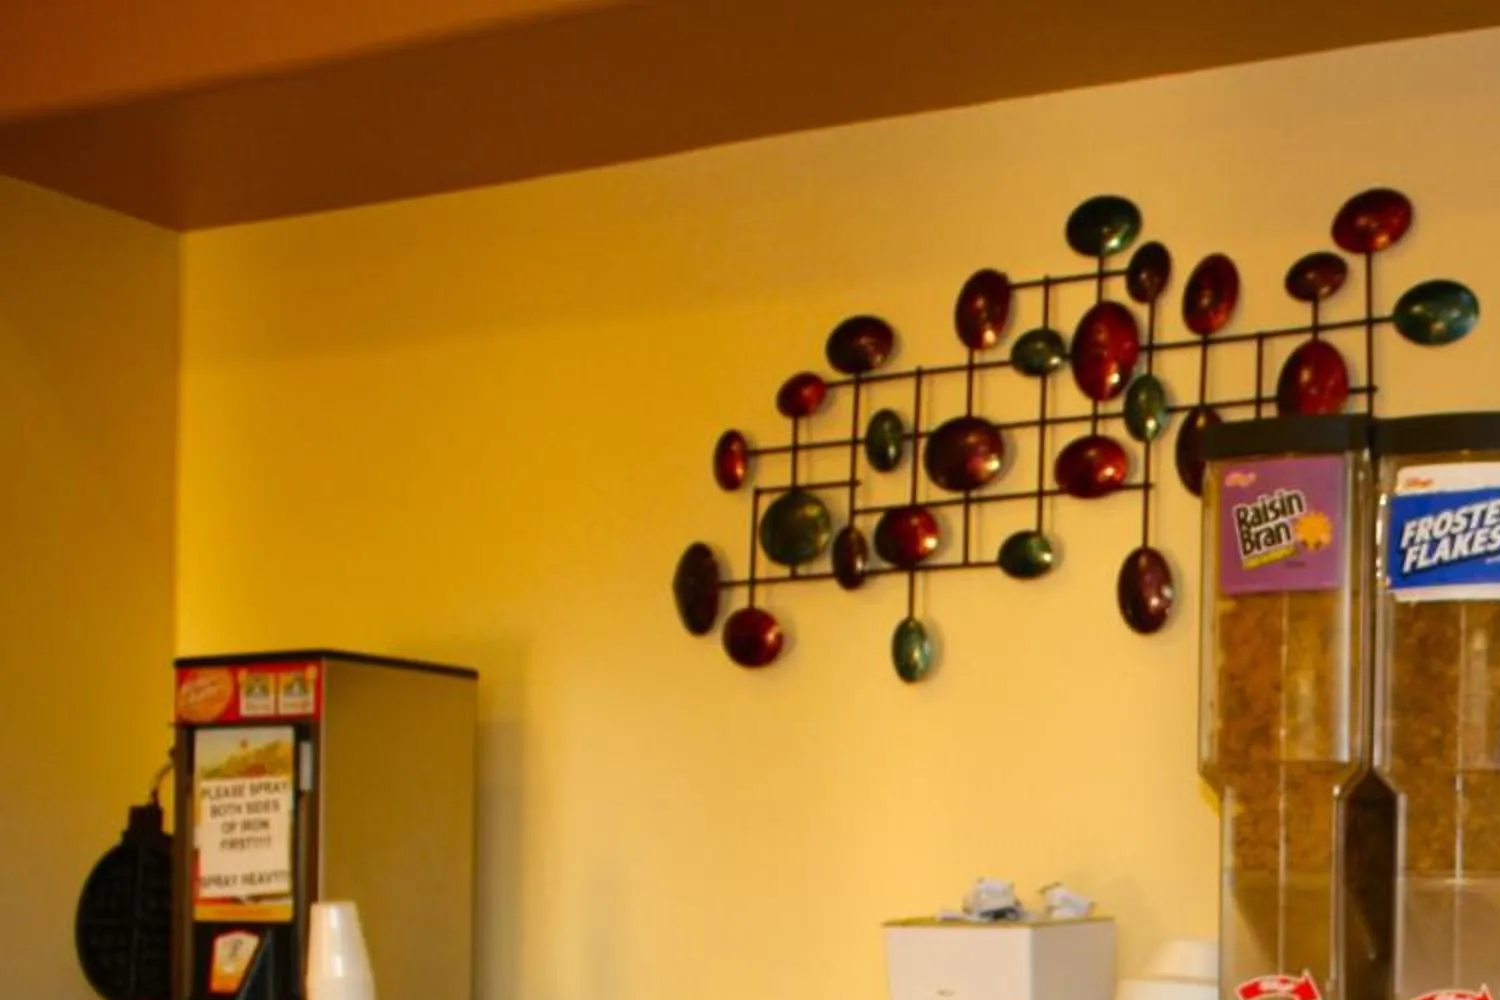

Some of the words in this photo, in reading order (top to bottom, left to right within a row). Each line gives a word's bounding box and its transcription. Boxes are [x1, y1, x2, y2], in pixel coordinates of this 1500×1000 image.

[1235, 492, 1304, 528] Raisin
[1240, 522, 1292, 556] Bran
[201, 784, 245, 800] PLEASE
[249, 781, 287, 796] SPRAY
[210, 803, 242, 818] BOTH
[246, 799, 280, 814] SIDES
[221, 821, 237, 834] OF
[241, 819, 270, 832] IRON
[201, 873, 238, 888] SPRAY
